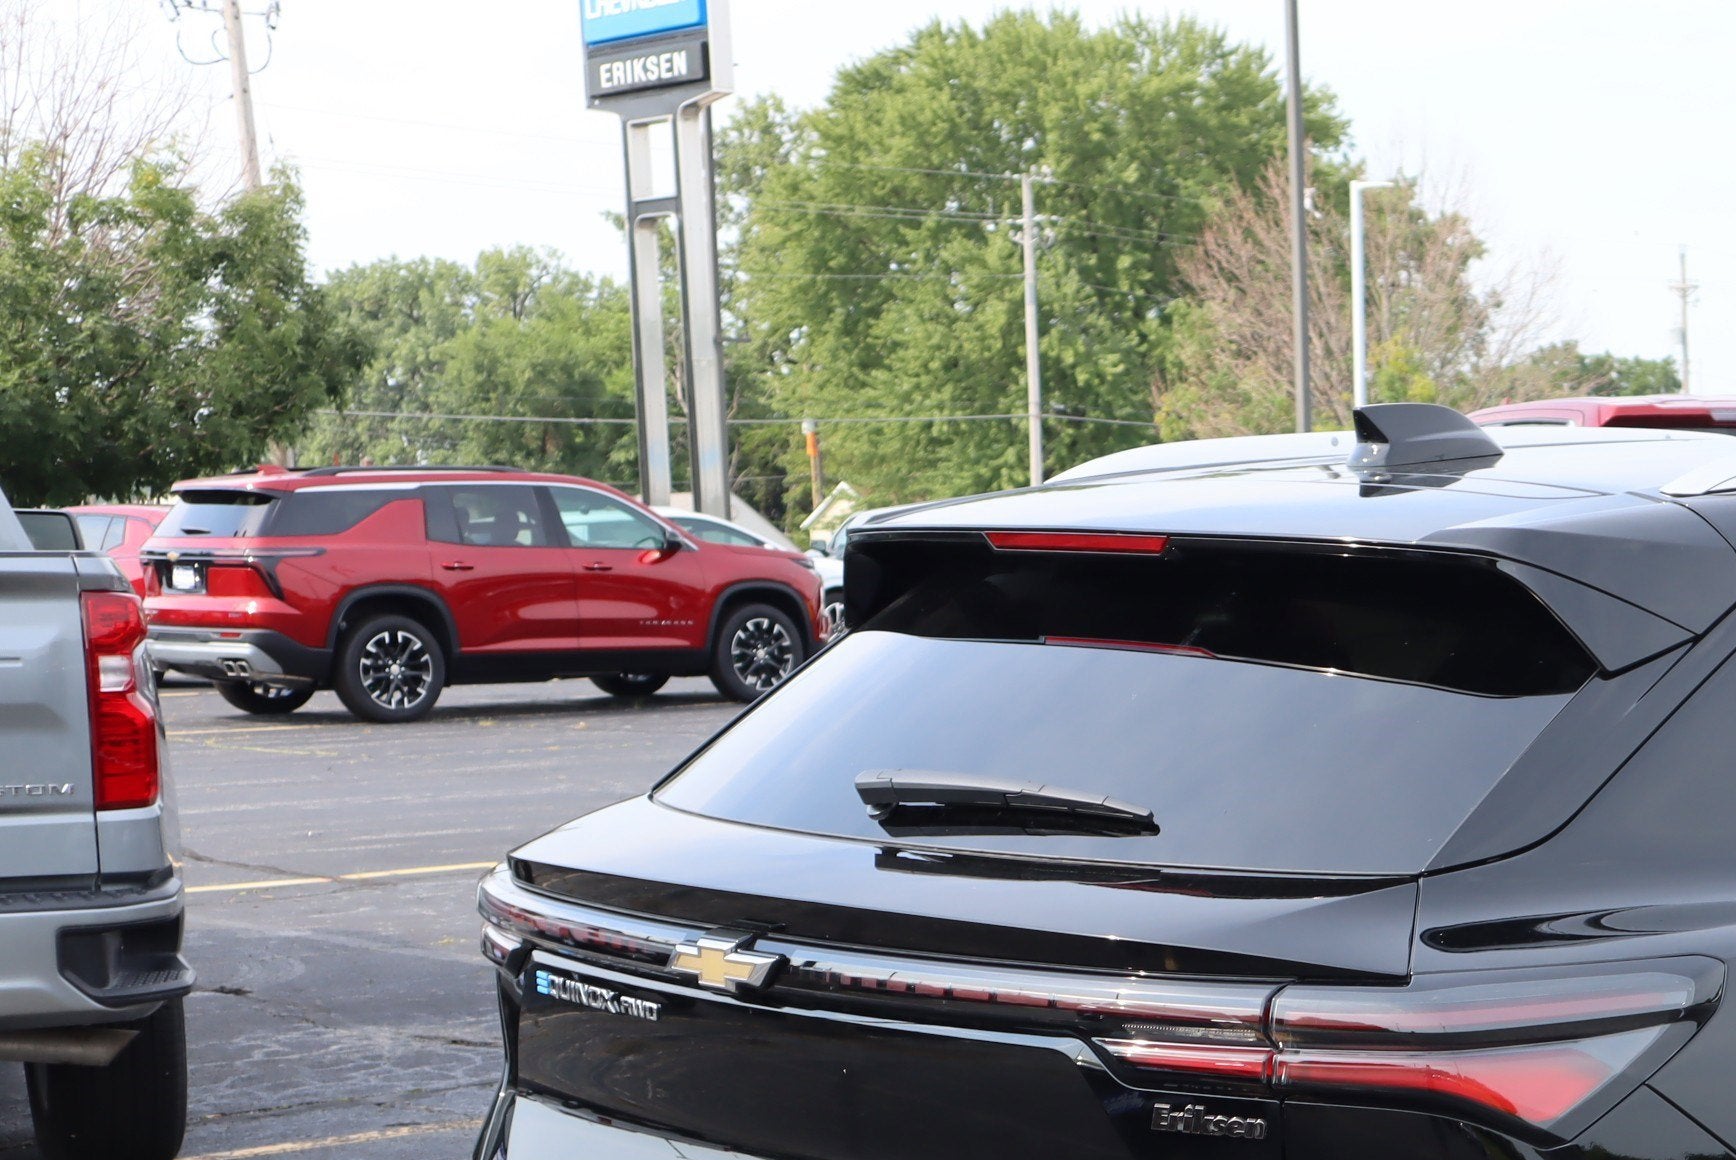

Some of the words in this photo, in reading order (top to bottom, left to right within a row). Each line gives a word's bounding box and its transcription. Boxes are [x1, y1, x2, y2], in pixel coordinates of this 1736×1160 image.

[599, 50, 688, 89] ERIKSEN
[535, 970, 620, 1015] EQUINOX
[1151, 1102, 1267, 1140] Eriksen
